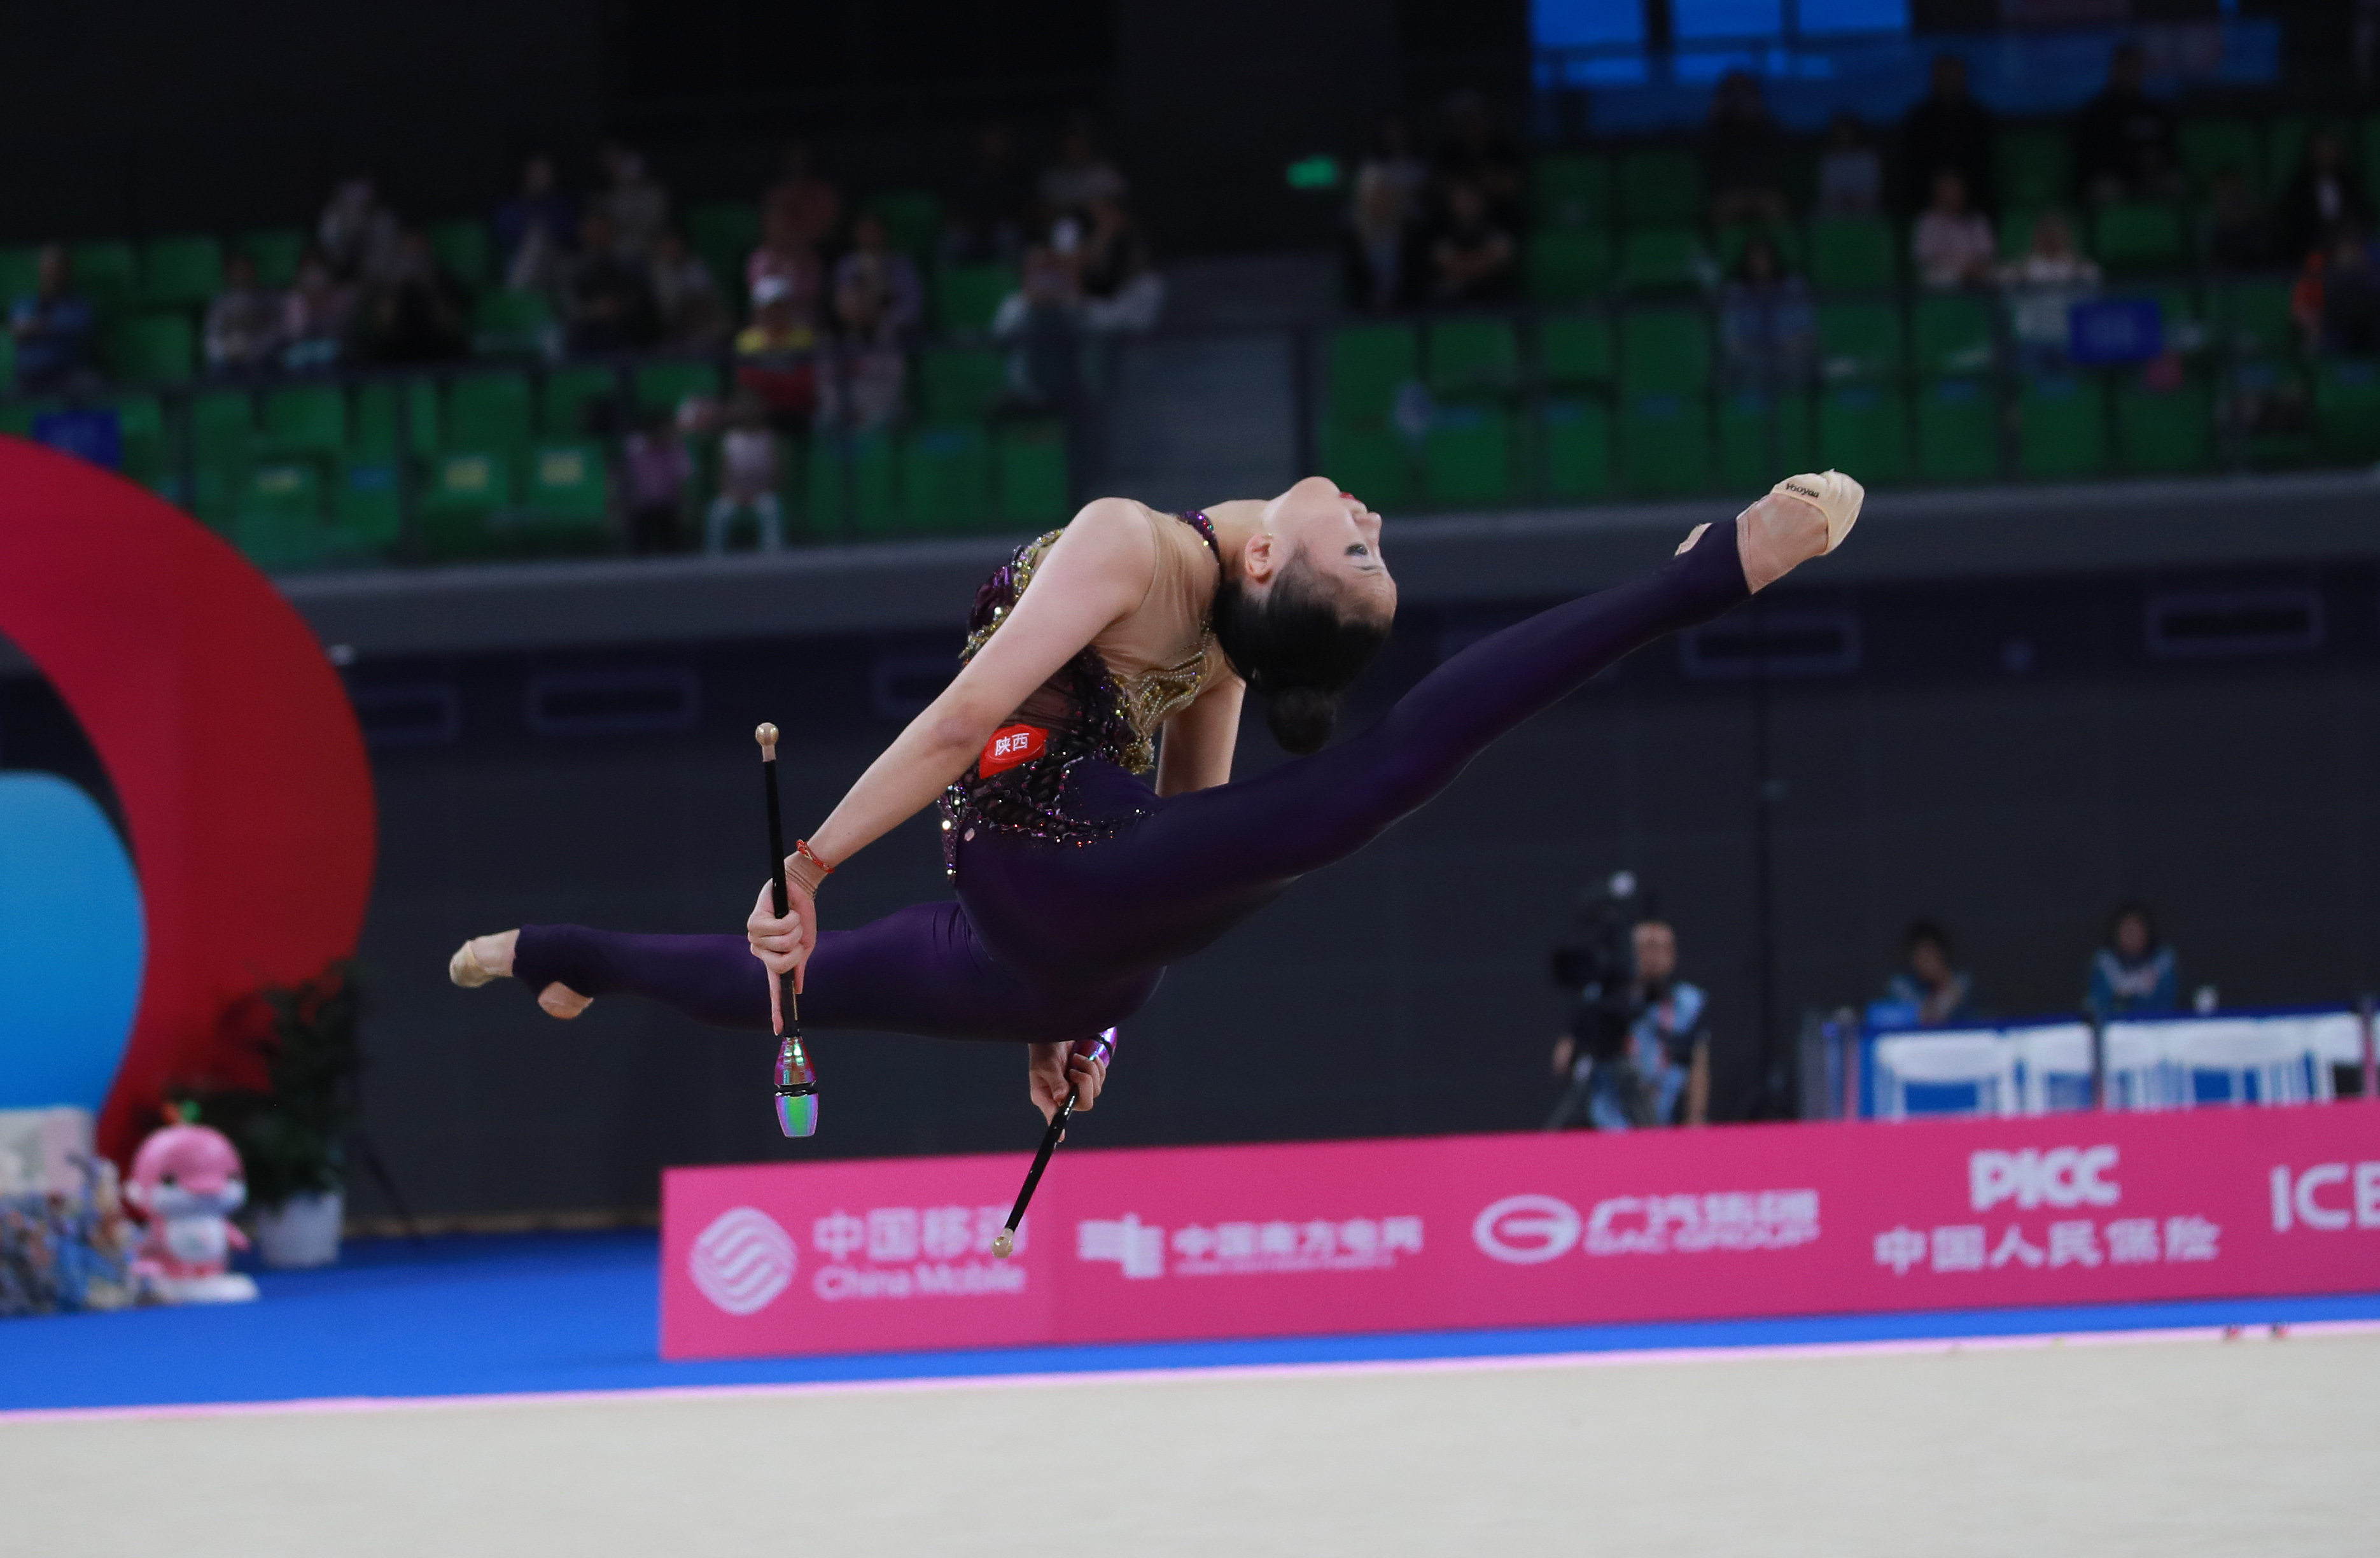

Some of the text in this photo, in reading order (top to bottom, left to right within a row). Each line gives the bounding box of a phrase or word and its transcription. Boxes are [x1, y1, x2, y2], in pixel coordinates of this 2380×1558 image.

[995, 733, 1030, 756] 陕西
[1969, 1144, 2122, 1212] PICC
[1873, 1216, 2221, 1275] 中国人民保险
